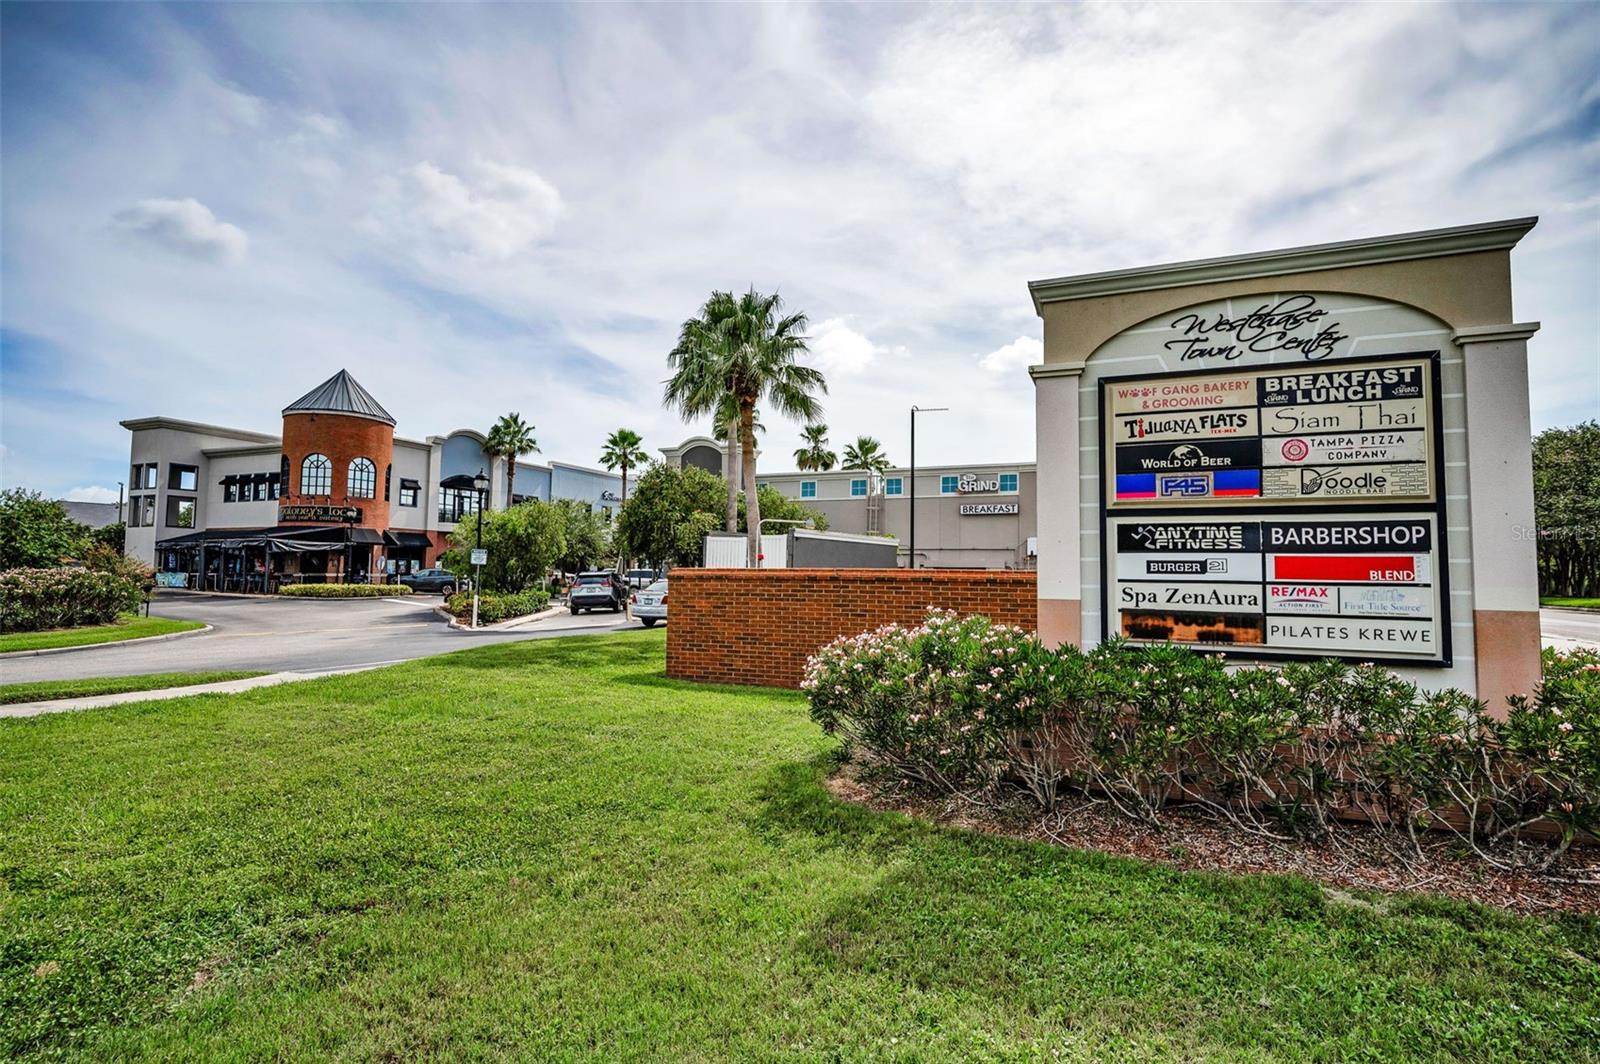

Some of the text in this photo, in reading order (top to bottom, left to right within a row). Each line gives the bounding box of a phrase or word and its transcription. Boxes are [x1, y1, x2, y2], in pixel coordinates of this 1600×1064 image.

[1170, 295, 1329, 342] Westchase
[1164, 322, 1350, 362] Town Center
[1265, 367, 1416, 392] BREAKFAST
[1161, 384, 1200, 396] GANG
[1203, 380, 1250, 393] BAKERY
[1296, 384, 1383, 404] LUNCH
[1142, 395, 1224, 409] & GROOMING
[1199, 413, 1248, 430] FLATS
[1271, 402, 1416, 433] Siam Thai
[1310, 435, 1405, 448] TAMPA PIZZA
[1327, 450, 1387, 461] COMPANY
[1161, 476, 1210, 497] F45
[1301, 468, 1387, 495] Doodle
[962, 504, 1016, 513] BREAKFAST
[1154, 526, 1242, 539] ANYTIME
[1271, 526, 1426, 545] BARBERSHOP
[1155, 538, 1245, 549] FITNESS
[1150, 560, 1226, 572] BURGER 21
[1369, 570, 1415, 581] BLEND
[1121, 587, 1259, 607] Spa ZenAura
[1271, 587, 1328, 597] RE/MAX
[1344, 601, 1364, 610] First
[1271, 625, 1431, 642] PILATES KREWE
